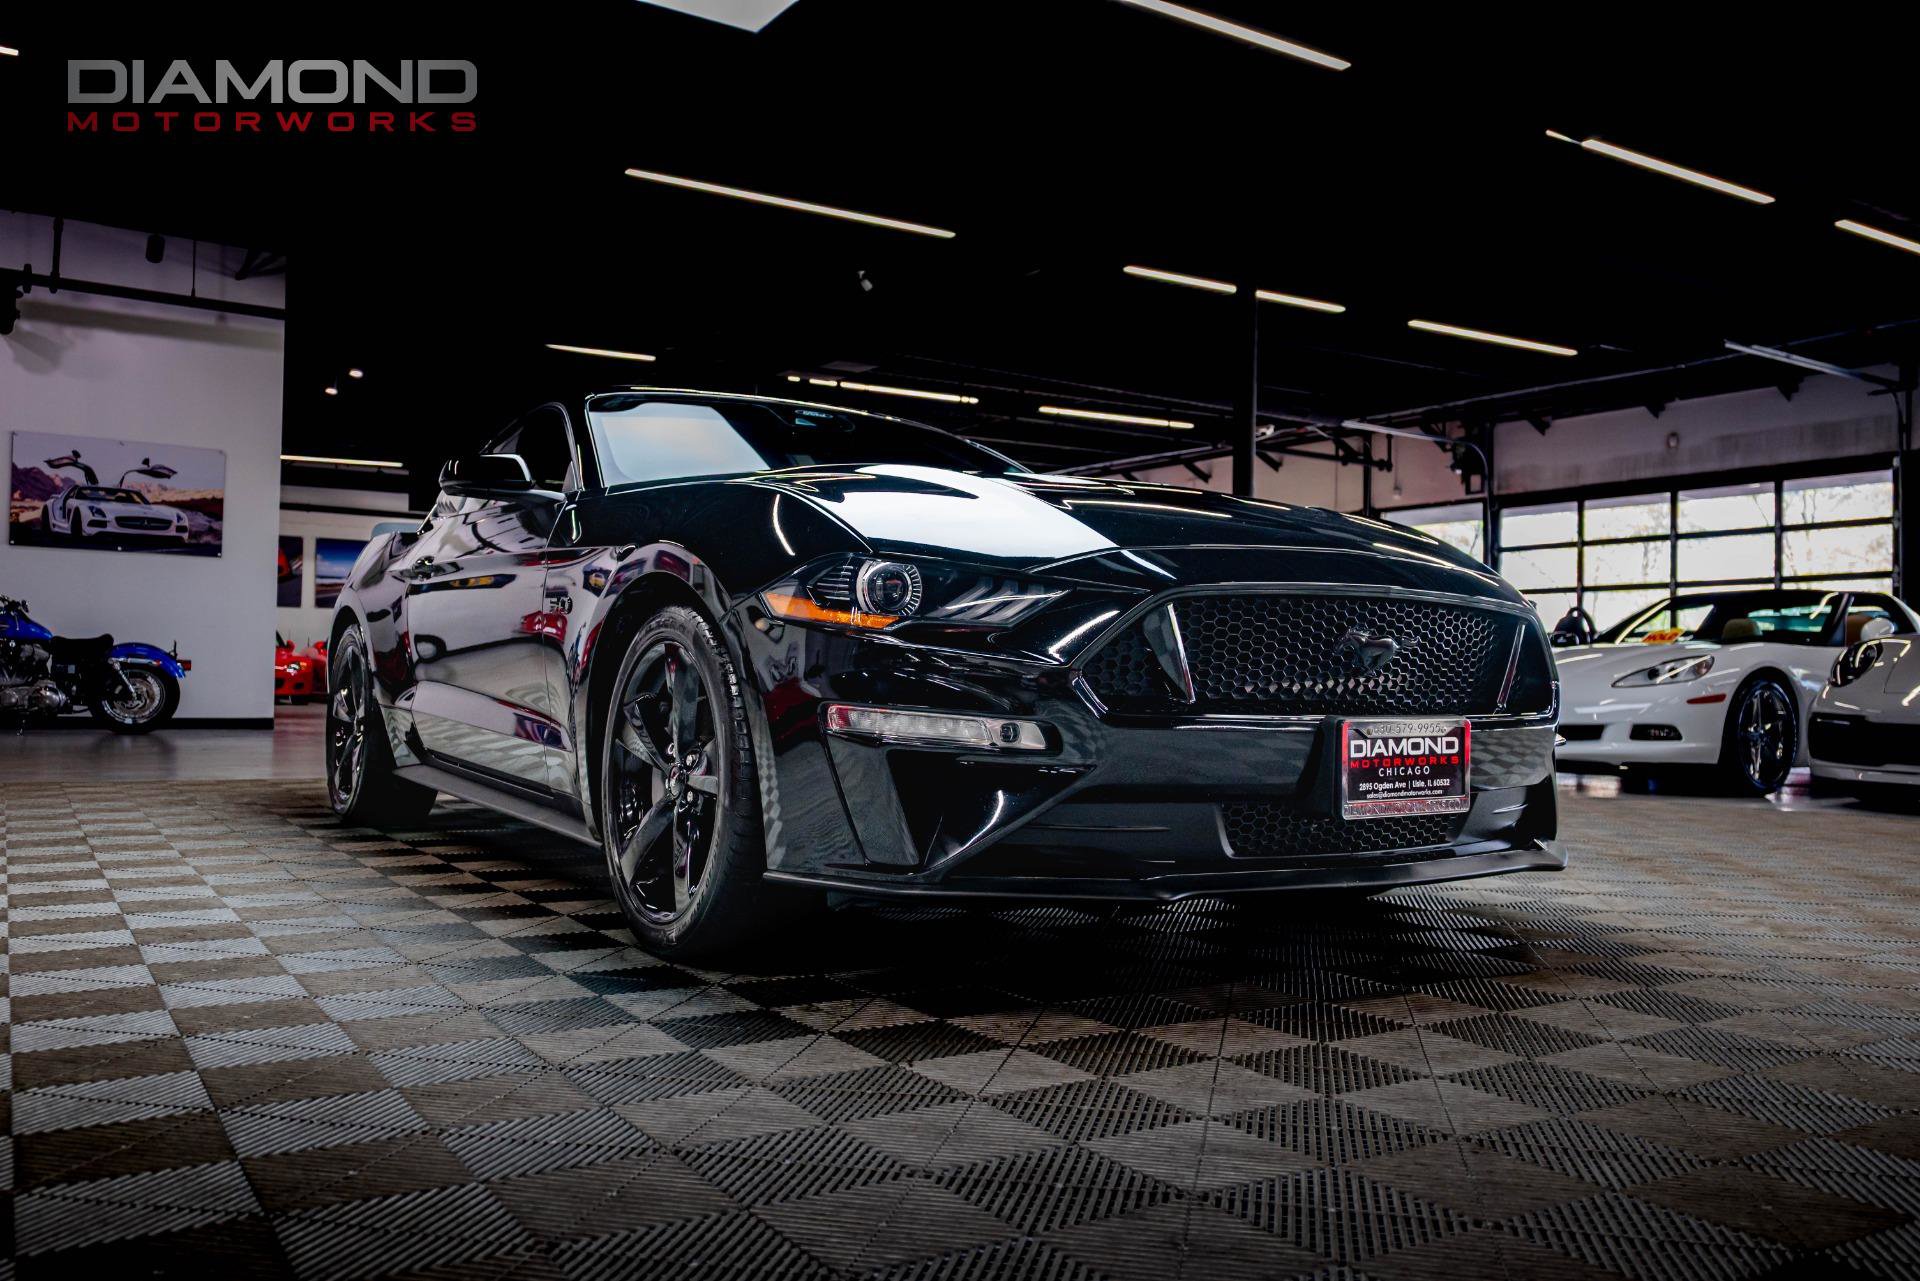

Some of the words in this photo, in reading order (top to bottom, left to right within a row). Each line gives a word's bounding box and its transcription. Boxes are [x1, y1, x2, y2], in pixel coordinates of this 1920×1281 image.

[1350, 737, 1459, 758] DIAMOND
[1350, 756, 1460, 768] MOTORWORKS
[1379, 766, 1430, 777] CHICAGO
[1374, 783, 1394, 791] Ogden
[1434, 779, 1450, 787] 60532
